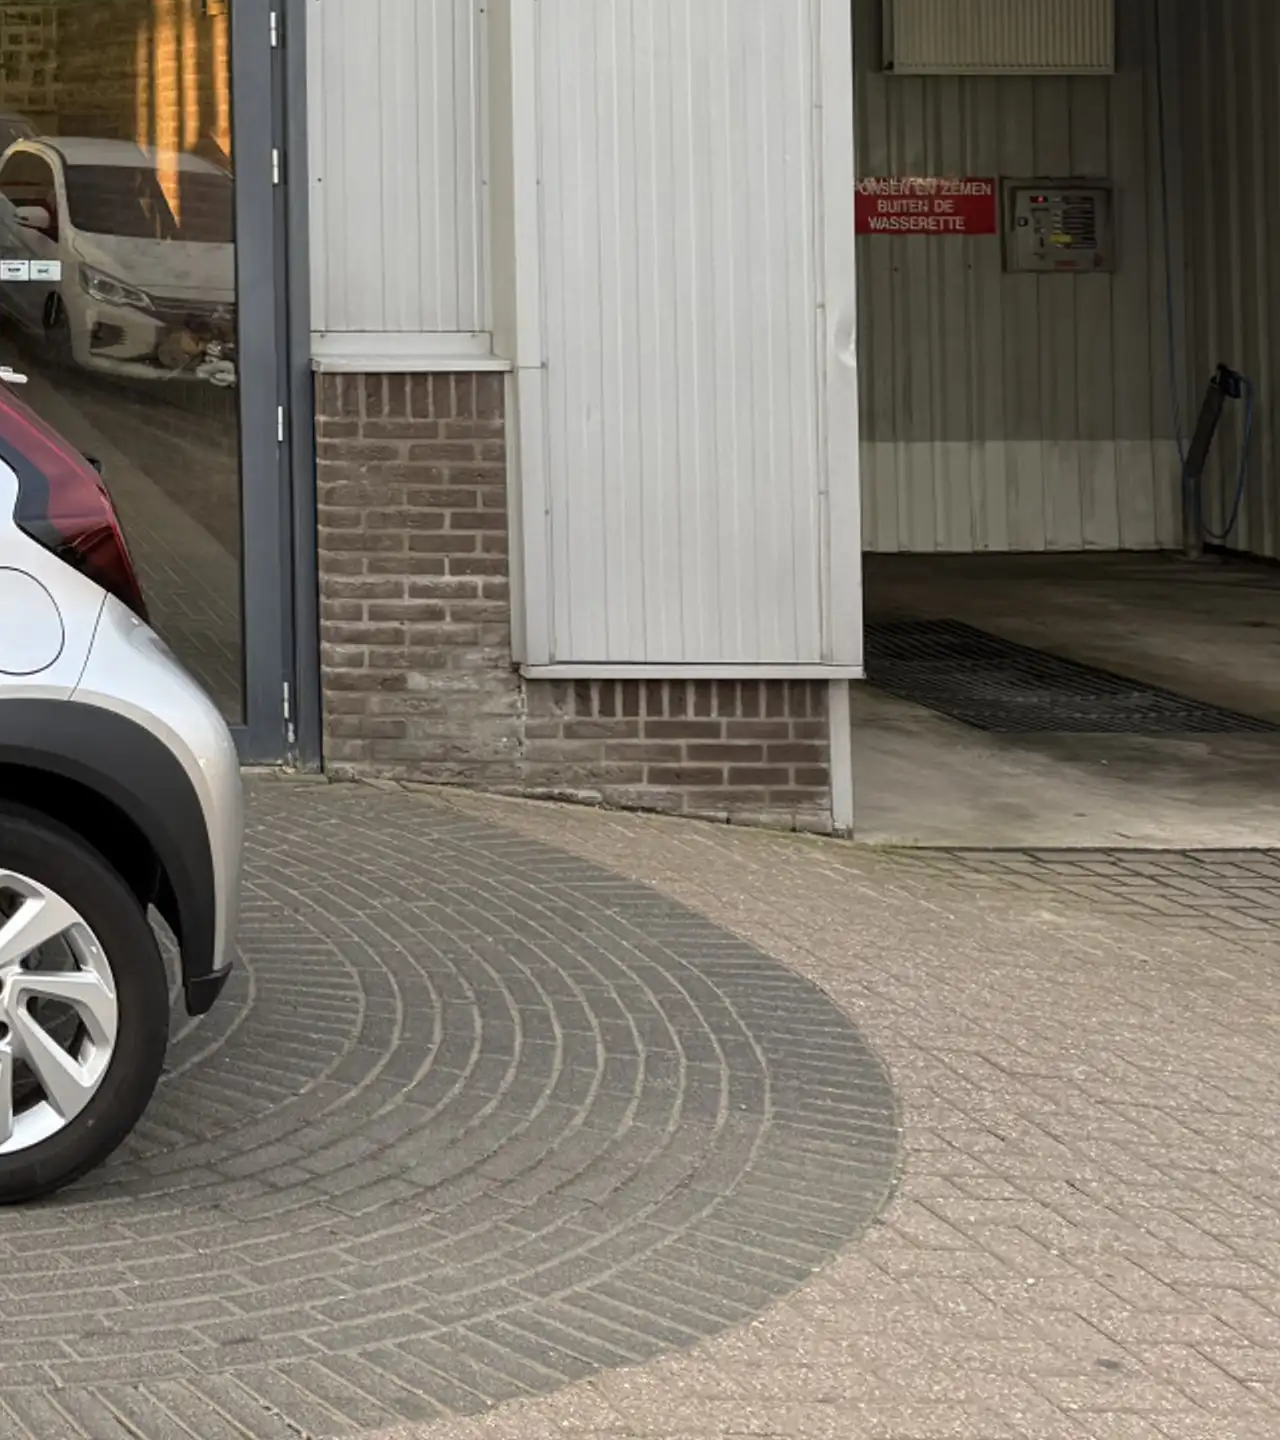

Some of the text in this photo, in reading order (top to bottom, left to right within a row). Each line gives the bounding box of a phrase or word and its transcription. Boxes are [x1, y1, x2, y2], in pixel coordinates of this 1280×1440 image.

[877, 199, 955, 213] BUITEN DE
[867, 216, 966, 230] WASSERETTE
